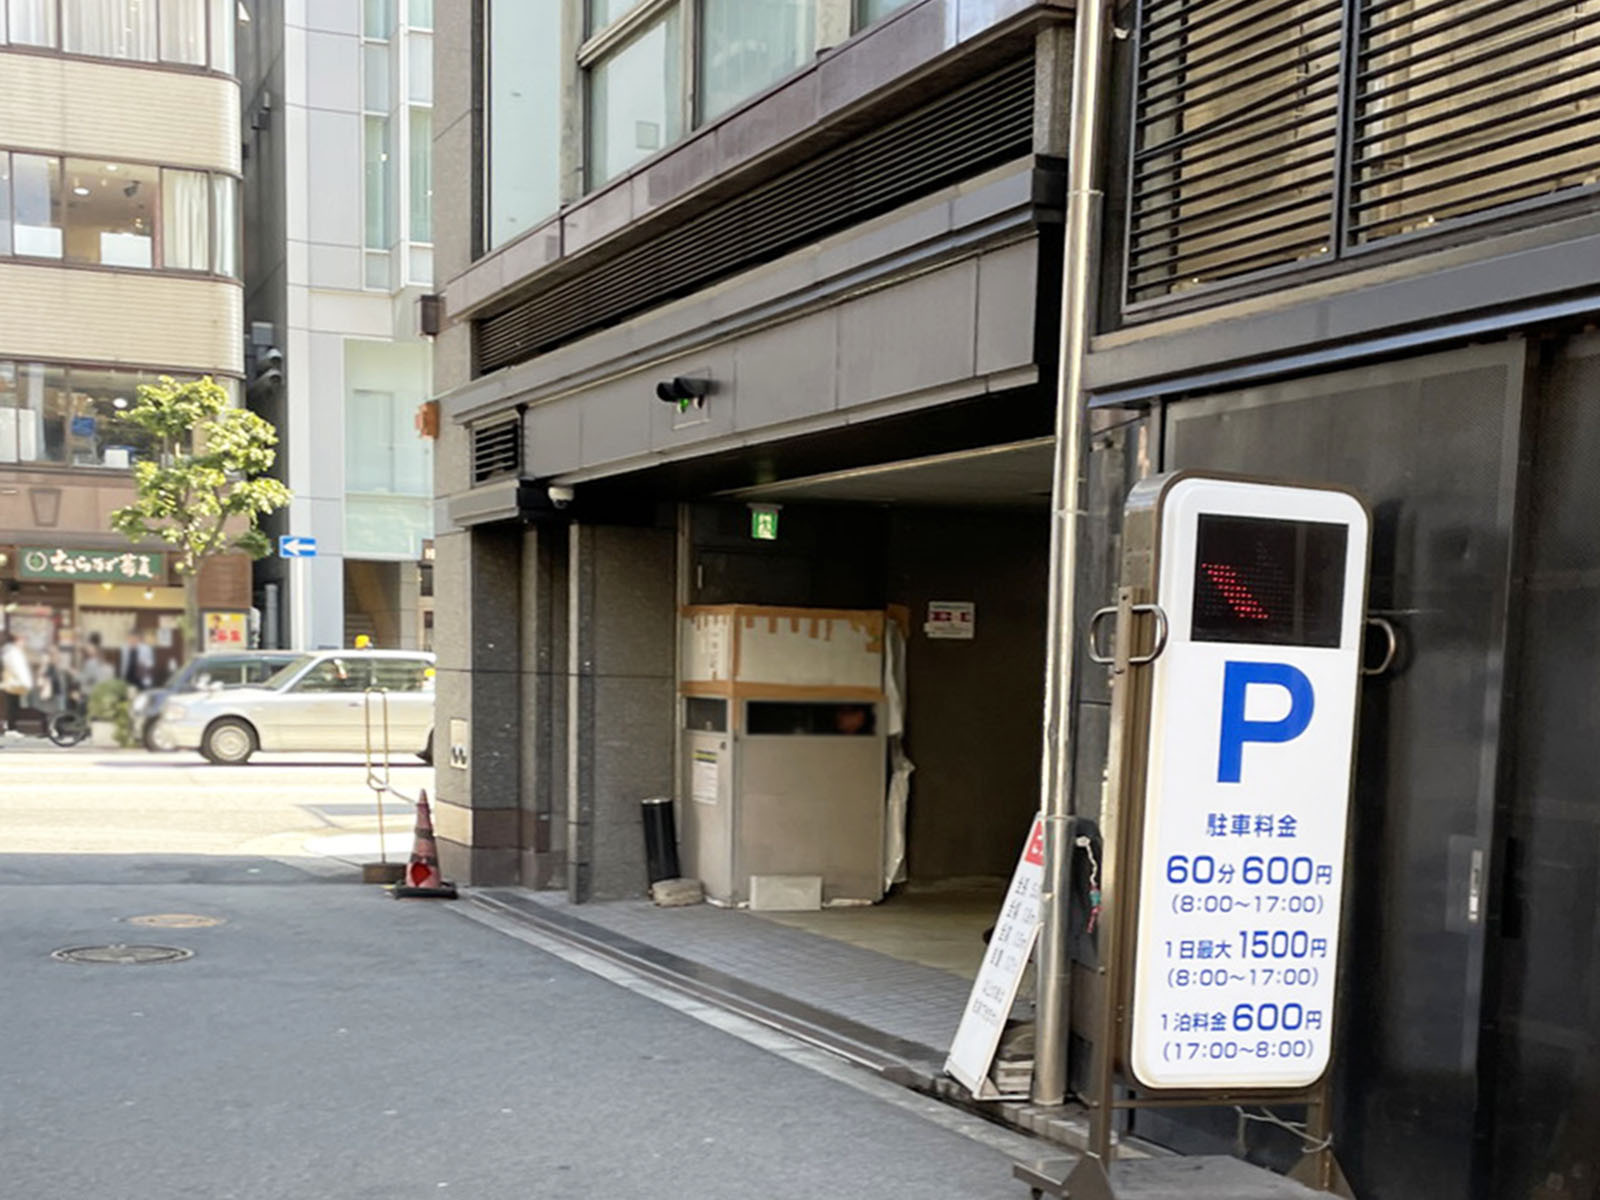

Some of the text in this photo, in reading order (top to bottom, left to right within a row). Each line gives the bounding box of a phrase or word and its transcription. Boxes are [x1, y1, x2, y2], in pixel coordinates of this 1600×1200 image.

[1216, 660, 1315, 784] P
[1207, 813, 1298, 838] 駐車料金
